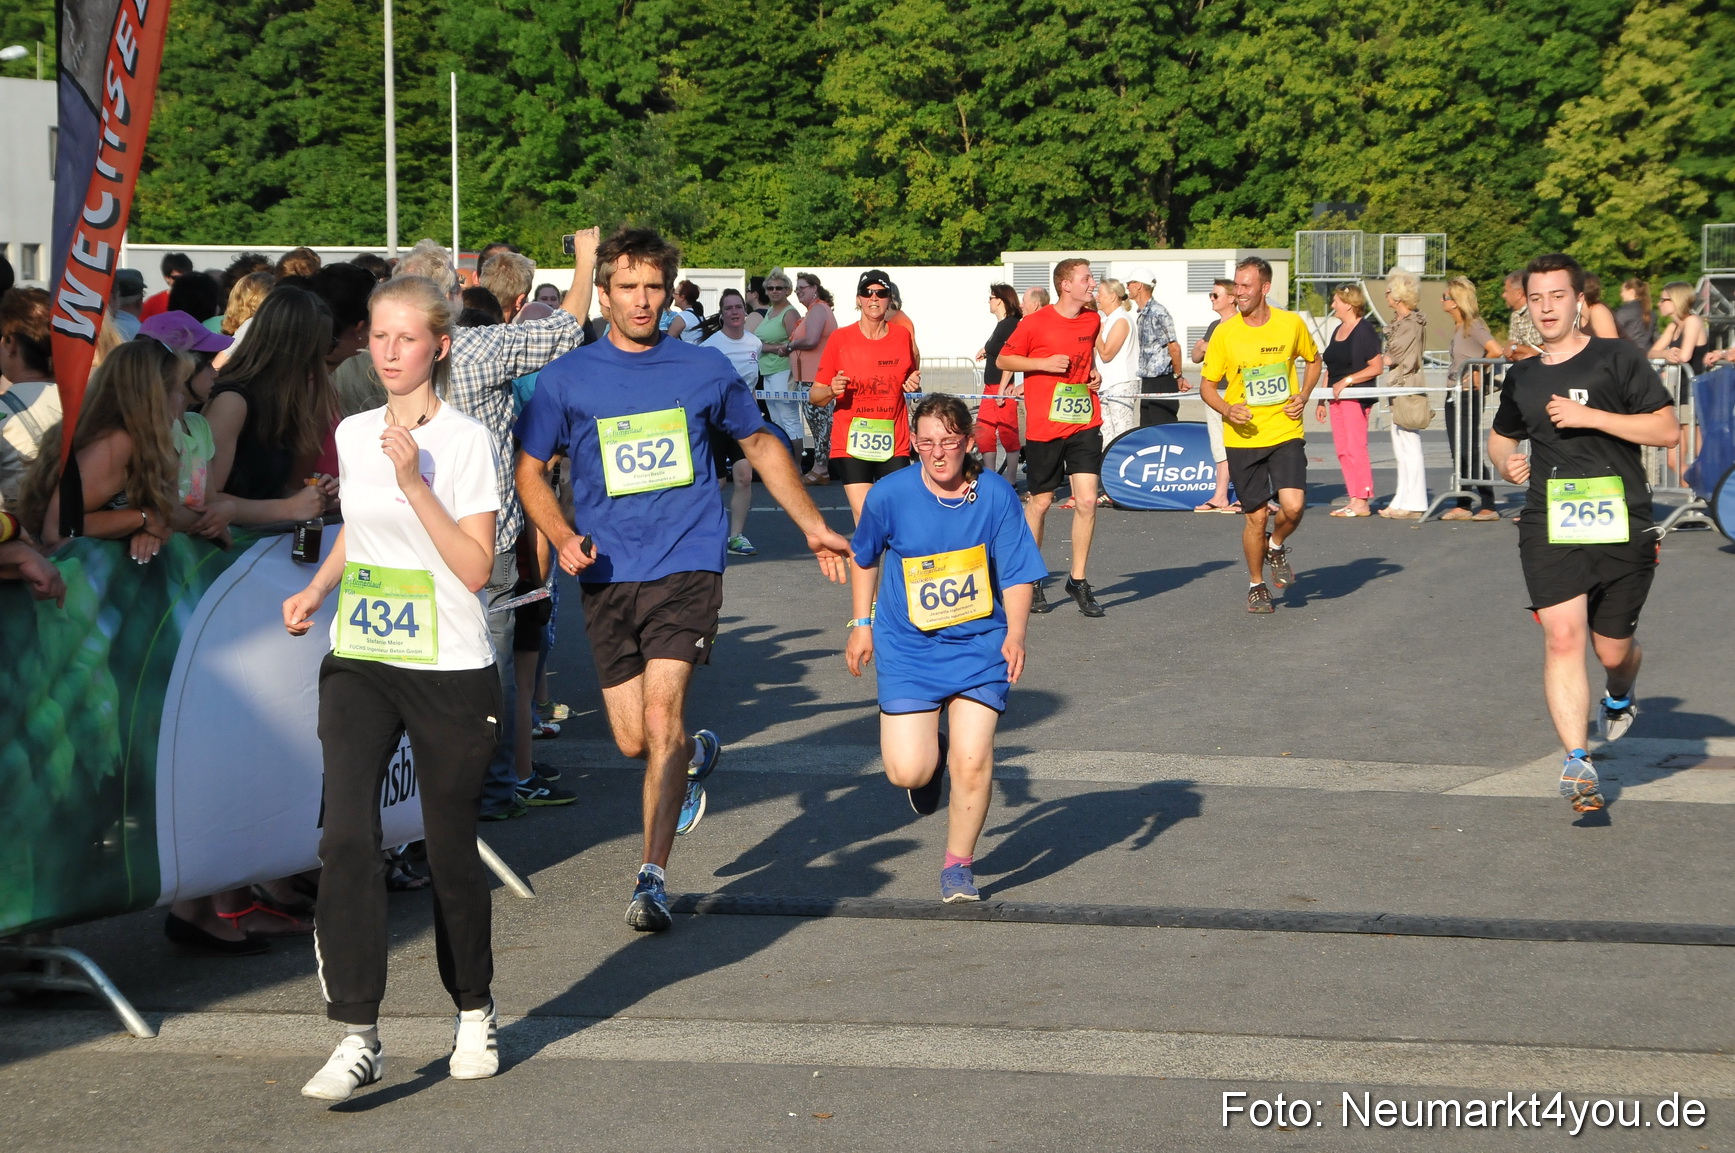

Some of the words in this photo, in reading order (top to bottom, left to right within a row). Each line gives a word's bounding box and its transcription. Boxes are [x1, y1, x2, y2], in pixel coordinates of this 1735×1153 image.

[1246, 376, 1287, 397] 1350
[1054, 397, 1091, 414] 1353
[850, 432, 892, 451] 1359
[615, 437, 678, 474] 652
[1141, 460, 1217, 482] Fisch
[1560, 500, 1615, 527] 265
[920, 573, 979, 610] 664
[349, 598, 420, 637] 434
